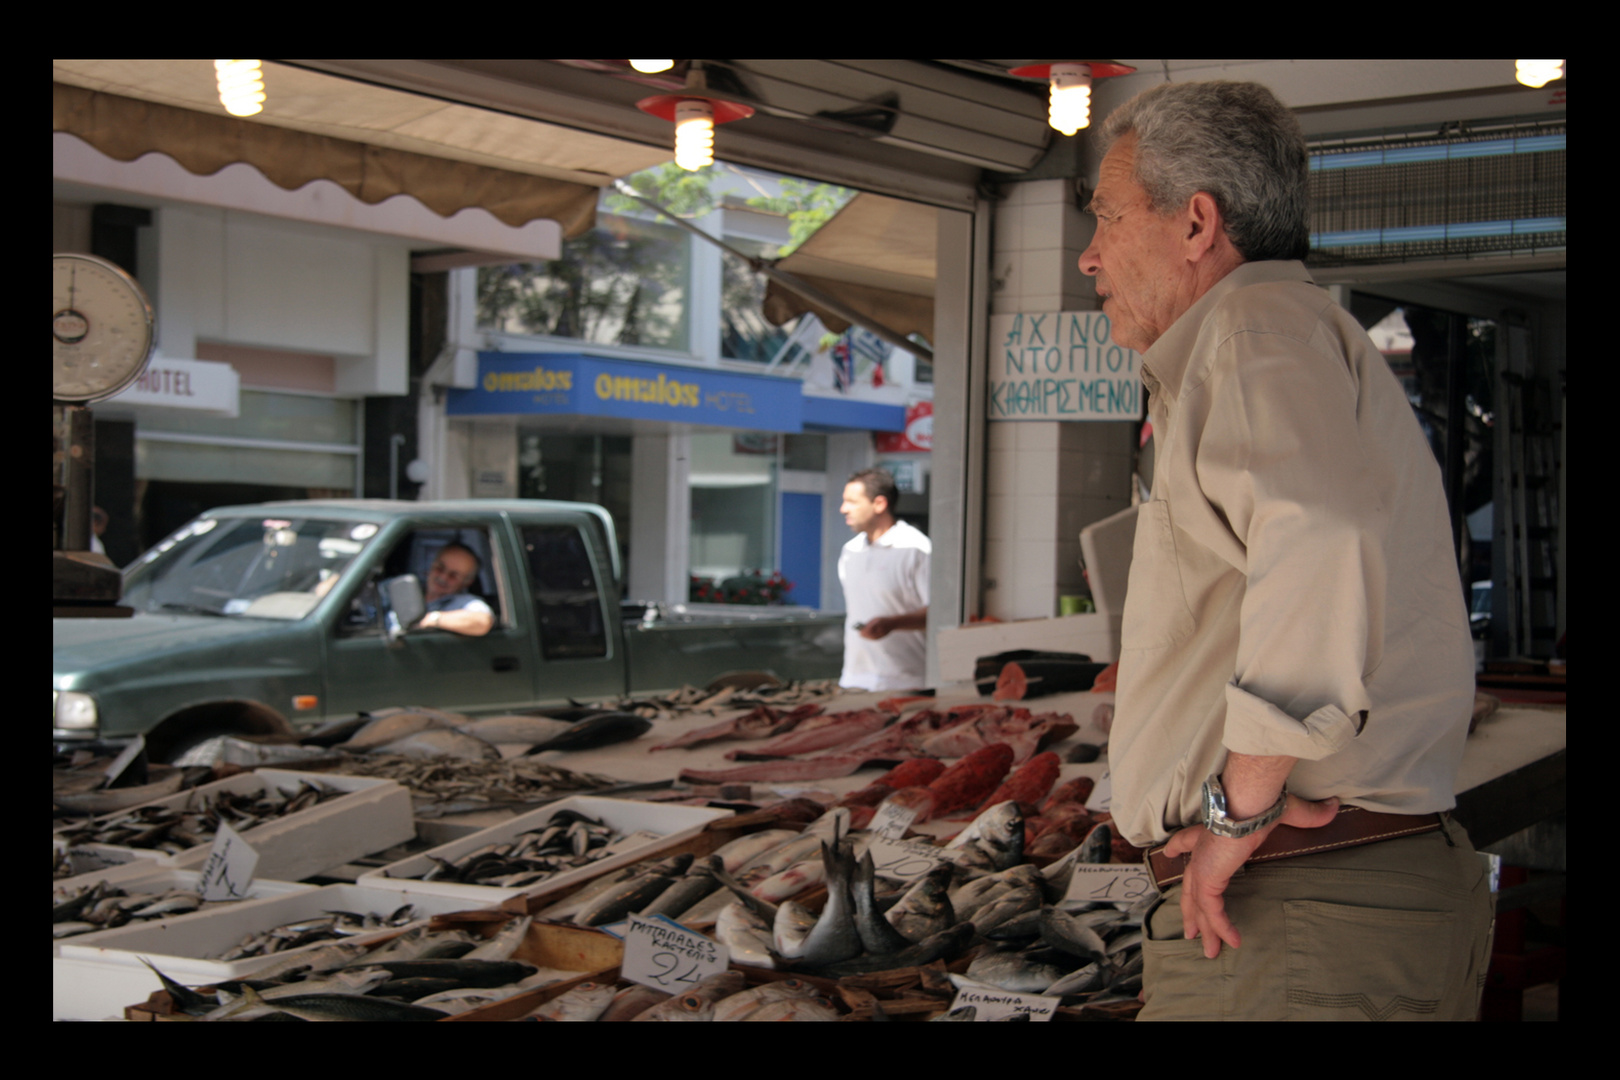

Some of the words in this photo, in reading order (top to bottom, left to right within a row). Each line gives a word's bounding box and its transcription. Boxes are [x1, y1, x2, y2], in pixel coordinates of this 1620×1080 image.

[1003, 312, 1111, 346] ΑΧΙΝΟ
[1006, 344, 1134, 375] ΝΤΟΠΙΟΙ
[136, 368, 196, 396] HOTEL
[482, 366, 573, 392] omalos
[594, 373, 700, 407] omalos
[704, 391, 756, 414] HOTEL
[877, 856, 933, 876] 10
[1090, 876, 1149, 899] 12
[647, 952, 702, 985] 24
